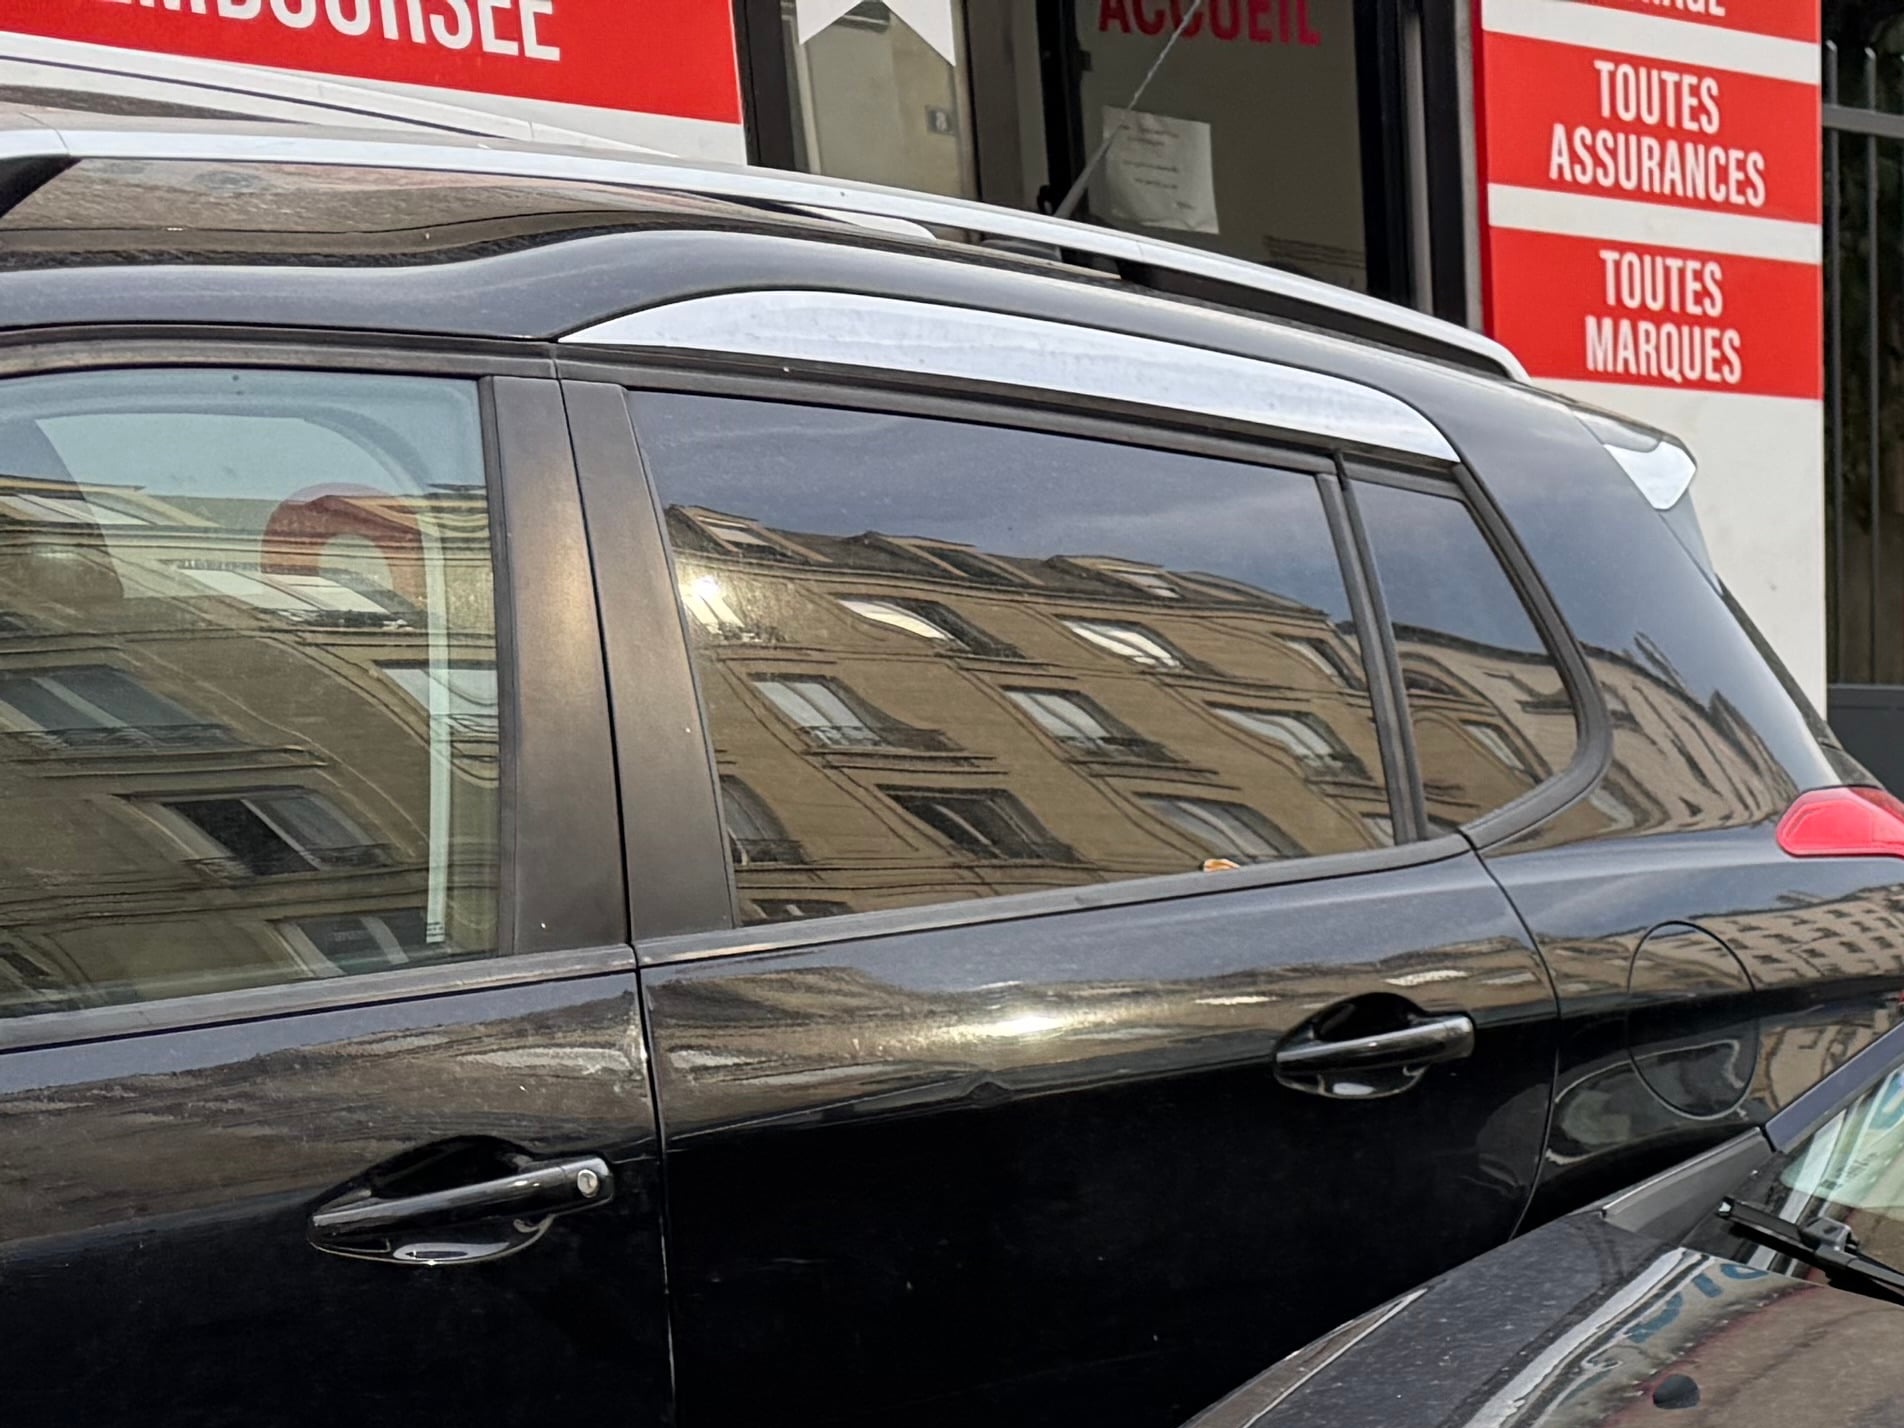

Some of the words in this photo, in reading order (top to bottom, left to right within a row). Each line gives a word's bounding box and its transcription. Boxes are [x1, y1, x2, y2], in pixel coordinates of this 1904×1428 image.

[1593, 59, 1720, 135] TOUTES
[1549, 122, 1766, 208] ASSURANCES
[1599, 249, 1723, 318] TOUTES
[1584, 315, 1742, 385] MARQUES
